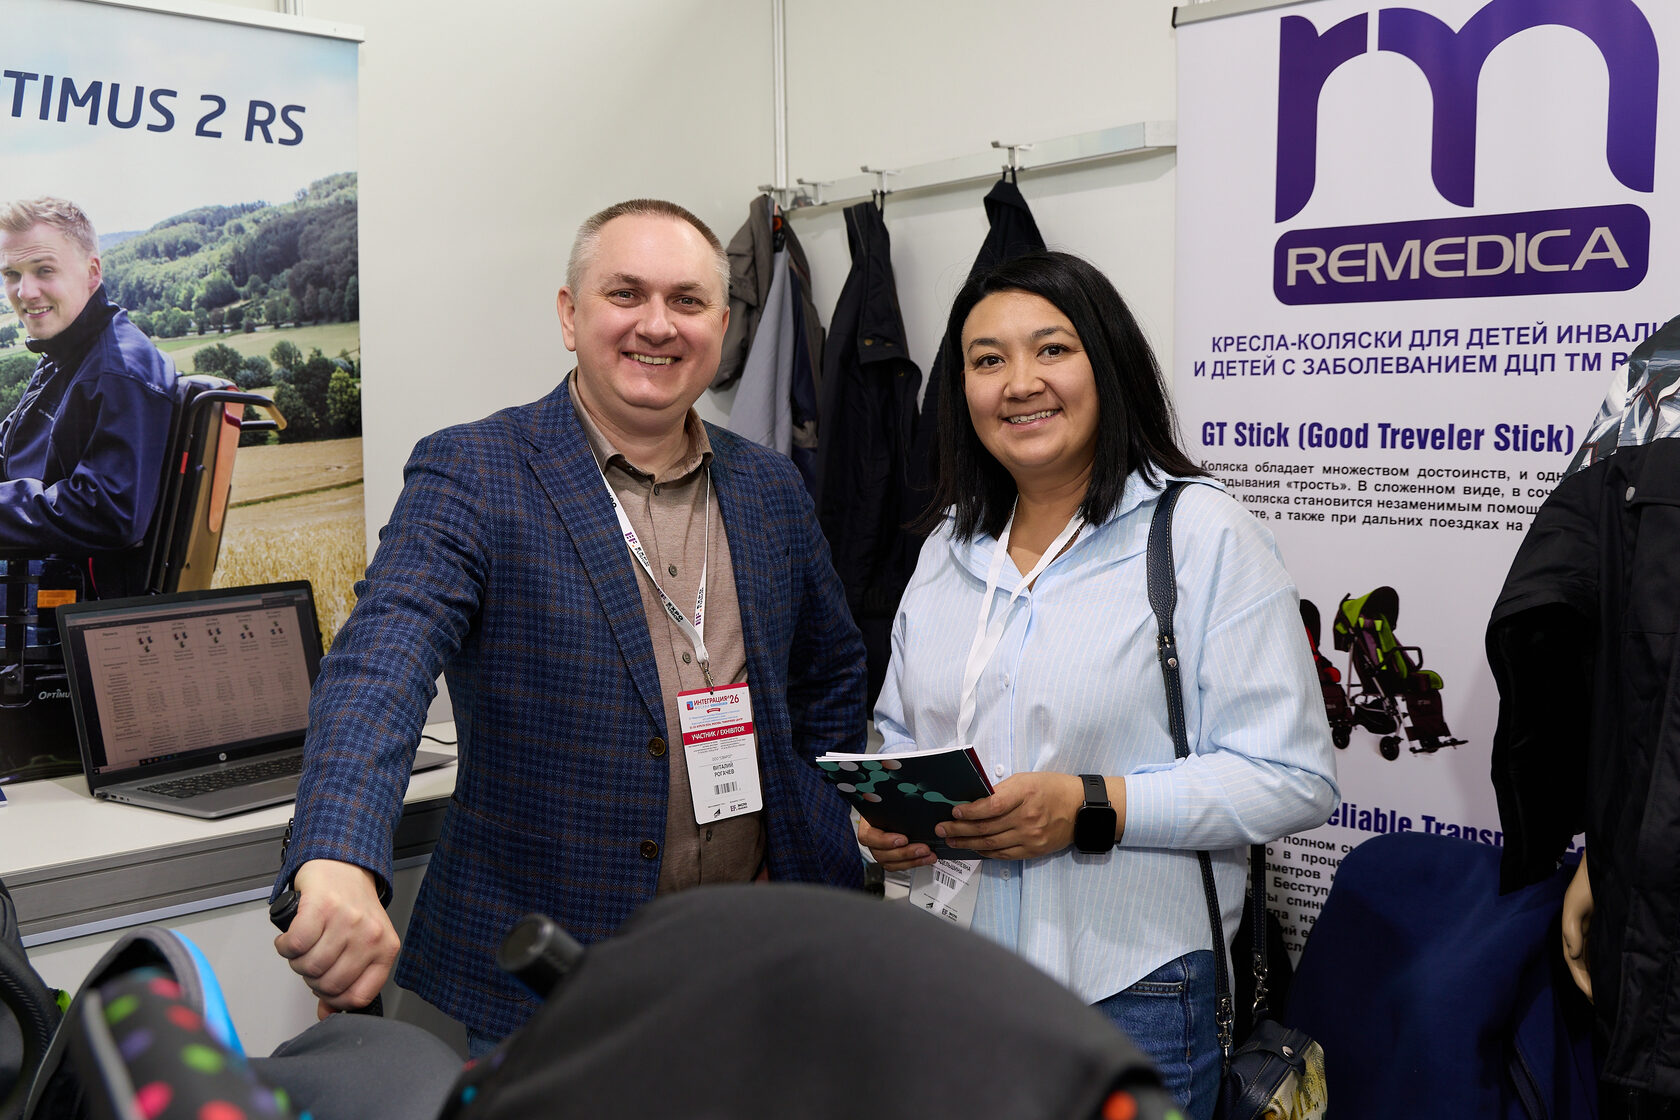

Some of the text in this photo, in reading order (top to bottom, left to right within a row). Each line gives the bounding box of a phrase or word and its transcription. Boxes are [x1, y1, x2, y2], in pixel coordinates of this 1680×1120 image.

[0, 70, 306, 146] TIMUS 2 RS
[1286, 226, 1630, 287] REMEDICA
[1211, 330, 1402, 353] КРЕСЛА-КОЛЯСКИ
[1408, 329, 1459, 351] ДЛЯ
[1466, 321, 1548, 350] ДЕТЕЙ
[1193, 360, 1206, 378] И
[1211, 354, 1275, 380] ДЕТЕЙ
[1282, 358, 1296, 376] С
[1302, 354, 1497, 376] ЗАБОЛЕВАНИЕМ
[1504, 353, 1556, 376] ДЦП
[1564, 352, 1601, 372] ТМ
[1202, 421, 1575, 456] GT Stick (Good Treveler Stick)
[1200, 460, 1564, 483] Коляска обладает множеством достоинств, и одн
[1357, 480, 1368, 492] В
[1374, 481, 1456, 495] сложенном
[1463, 485, 1505, 498] виде,
[1511, 487, 1521, 497] в
[1527, 488, 1552, 499] соч
[1242, 493, 1289, 505] коляска
[1293, 495, 1373, 508] становится
[1377, 499, 1482, 513] незаменимым
[1274, 511, 1282, 520] а
[1287, 511, 1326, 522] также
[1331, 513, 1357, 528] при
[1361, 514, 1424, 527] дальних
[1429, 517, 1500, 531] поездках
[1506, 521, 1523, 531] на
[1327, 801, 1412, 835] eliable
[1283, 835, 1336, 851] полном
[1283, 851, 1292, 860] в
[1301, 853, 1340, 868] проце
[1265, 862, 1321, 880] аметров
[1273, 876, 1328, 897] Бесступ
